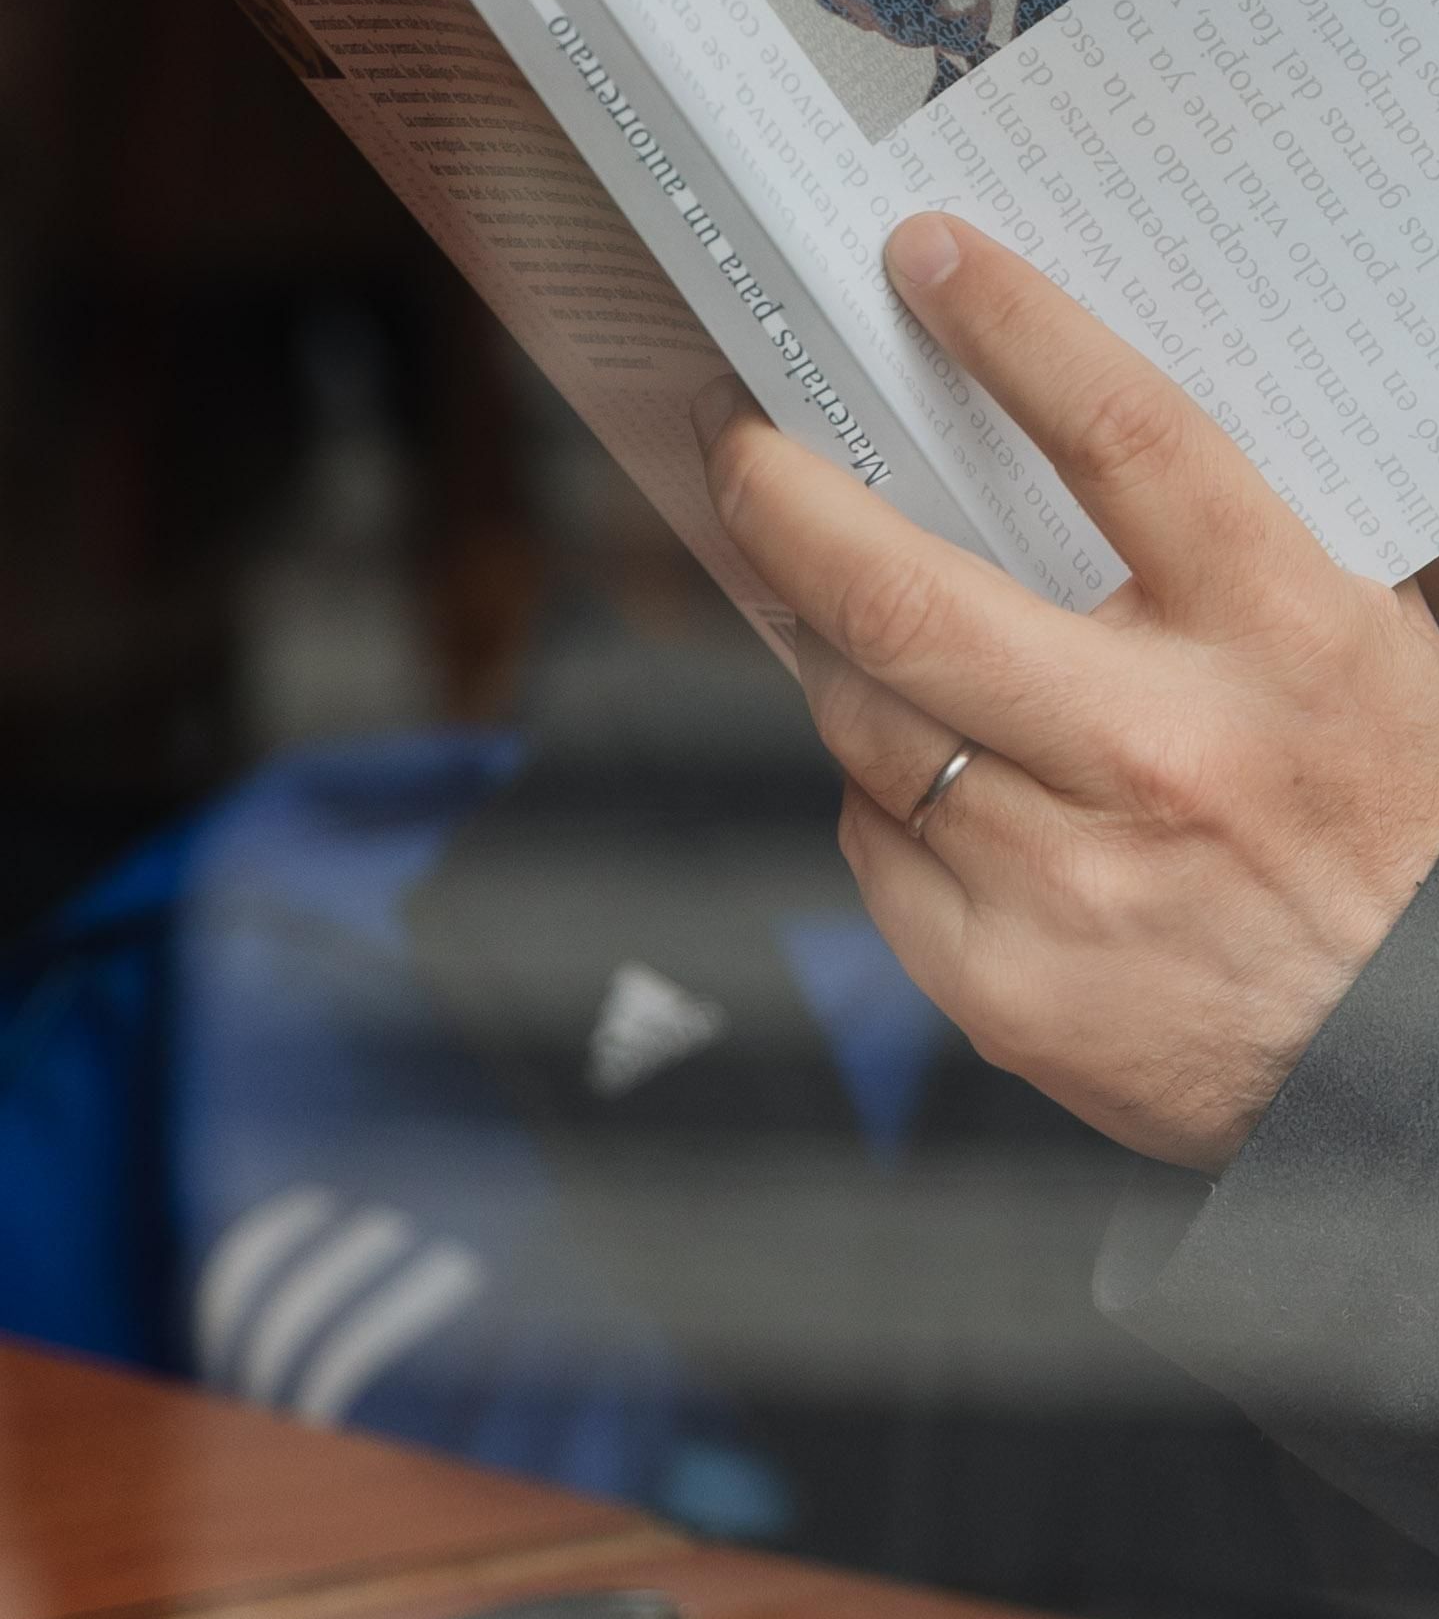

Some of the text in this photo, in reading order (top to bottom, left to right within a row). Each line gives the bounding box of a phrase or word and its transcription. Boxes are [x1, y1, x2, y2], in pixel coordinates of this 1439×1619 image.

[701, 36, 731, 72] se
[1017, 46, 1054, 87] de
[1148, 45, 1197, 94] ya
[1192, 8, 1287, 128] propia,
[1271, 47, 1323, 100] del
[760, 44, 846, 145] pivote
[1102, 71, 1137, 116] la
[1131, 110, 1156, 137] a
[1182, 95, 1238, 156] que
[735, 72, 839, 228] tentativa,
[836, 149, 869, 188] de
[1271, 129, 1349, 227] mano
[1319, 106, 1412, 210] garras
[1039, 170, 1123, 283] Walter
[1049, 90, 1229, 330] independizarse
[1222, 160, 1289, 239] vital
[548, 16, 892, 489] Materiales para un autorretrato
[1153, 143, 1292, 323] (escapando
[1339, 228, 1401, 286] por
[1288, 242, 1347, 313] ciclo
[1121, 275, 1202, 370] joven
[1221, 327, 1258, 367] de
[1345, 317, 1384, 368] un
[1180, 365, 1215, 398] el
[1286, 324, 1380, 447] alemán
[1382, 369, 1418, 412] en
[969, 408, 1026, 482] serie
[1210, 400, 1256, 443] ues
[1254, 370, 1351, 496] función
[1023, 480, 1072, 551] una
[1344, 494, 1381, 537] en
[1071, 547, 1104, 591] en
